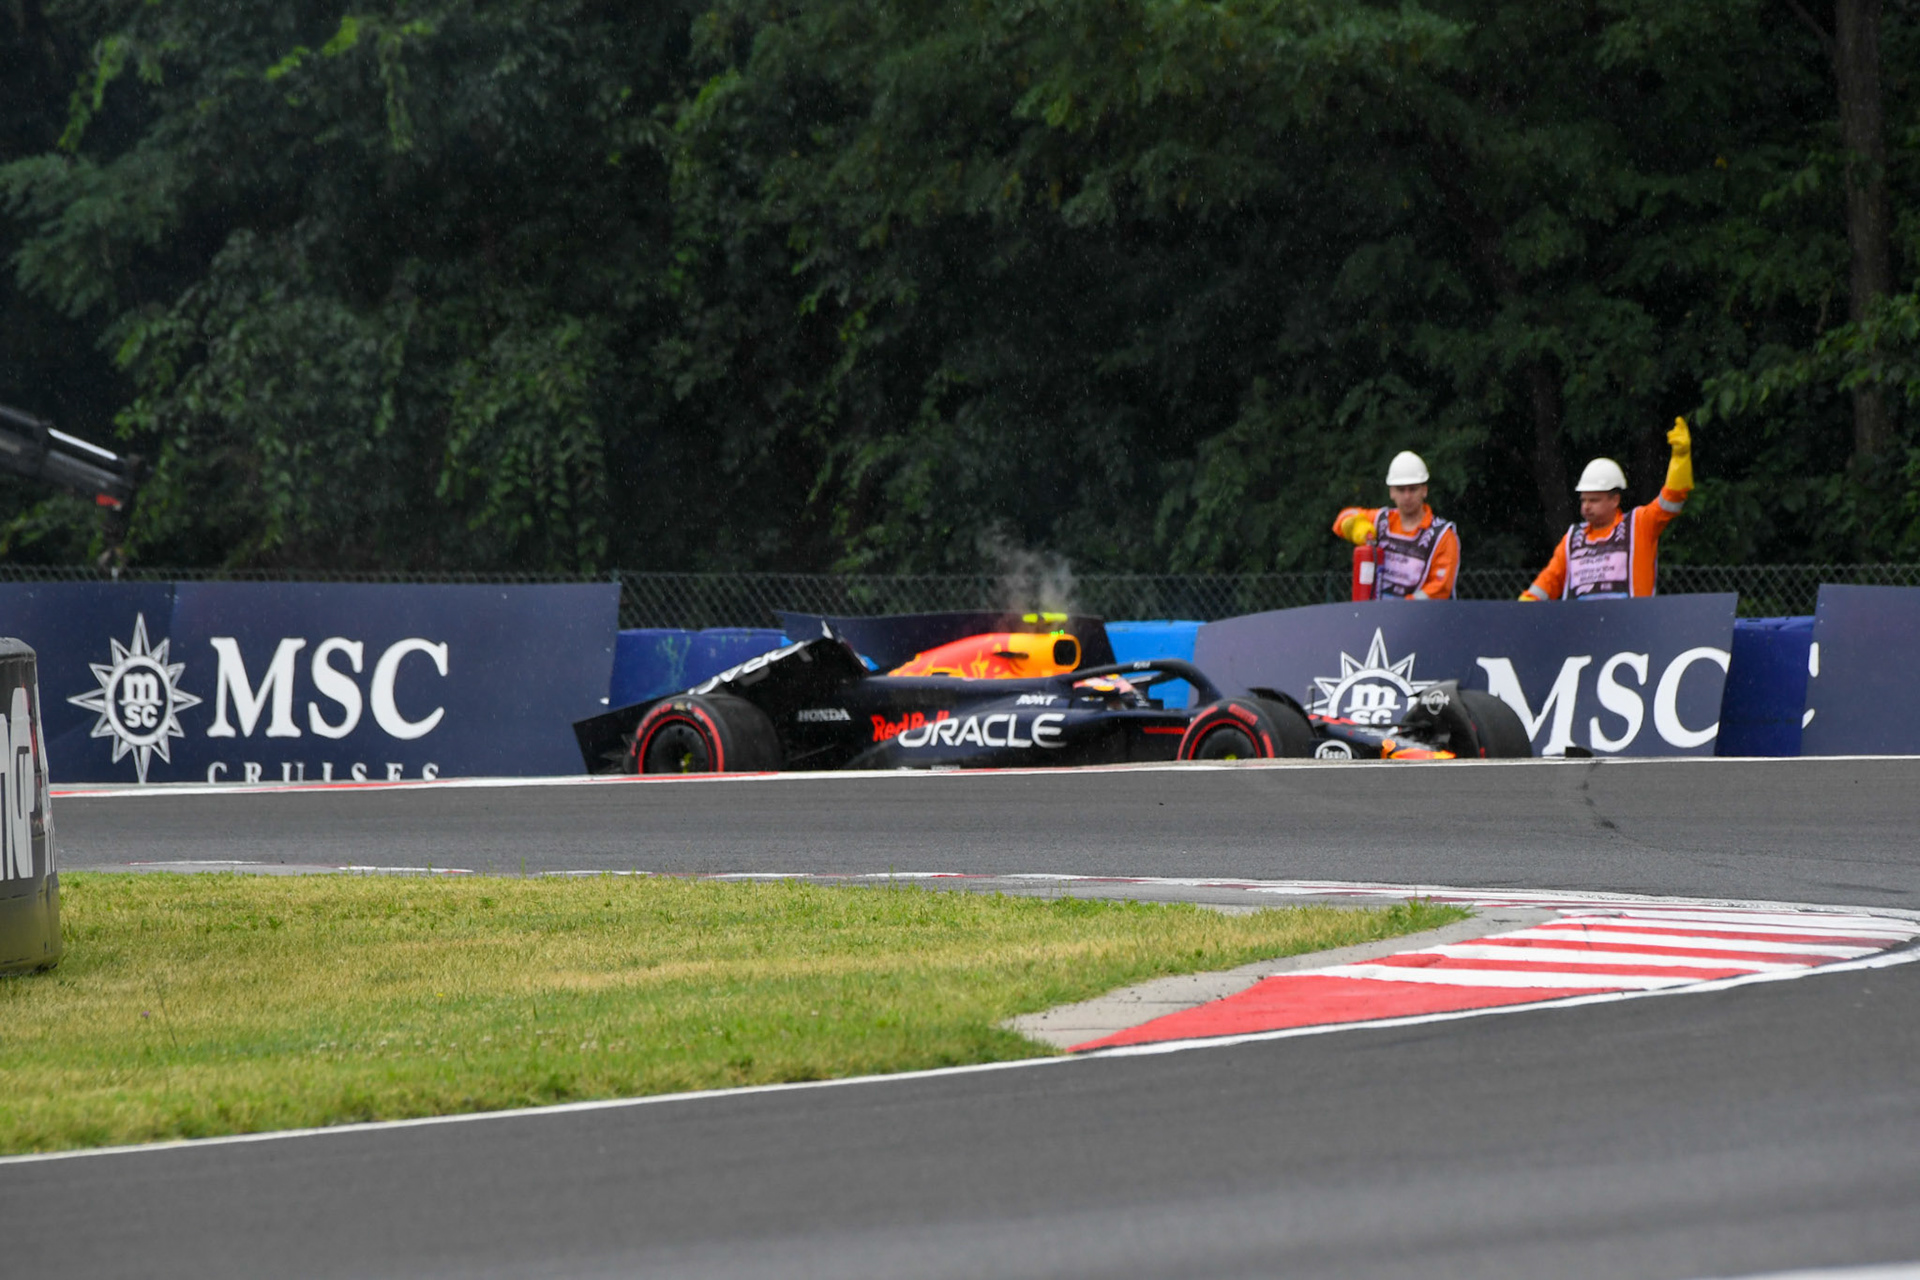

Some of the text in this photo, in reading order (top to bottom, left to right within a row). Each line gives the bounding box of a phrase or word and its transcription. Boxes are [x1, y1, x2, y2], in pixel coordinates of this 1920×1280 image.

[206, 636, 449, 740] MSC
[1476, 646, 1732, 757] MSC
[798, 708, 852, 722] HONDA
[871, 713, 909, 742] Red
[898, 713, 1067, 748] ORACLE
[207, 761, 439, 783] CRUISES
